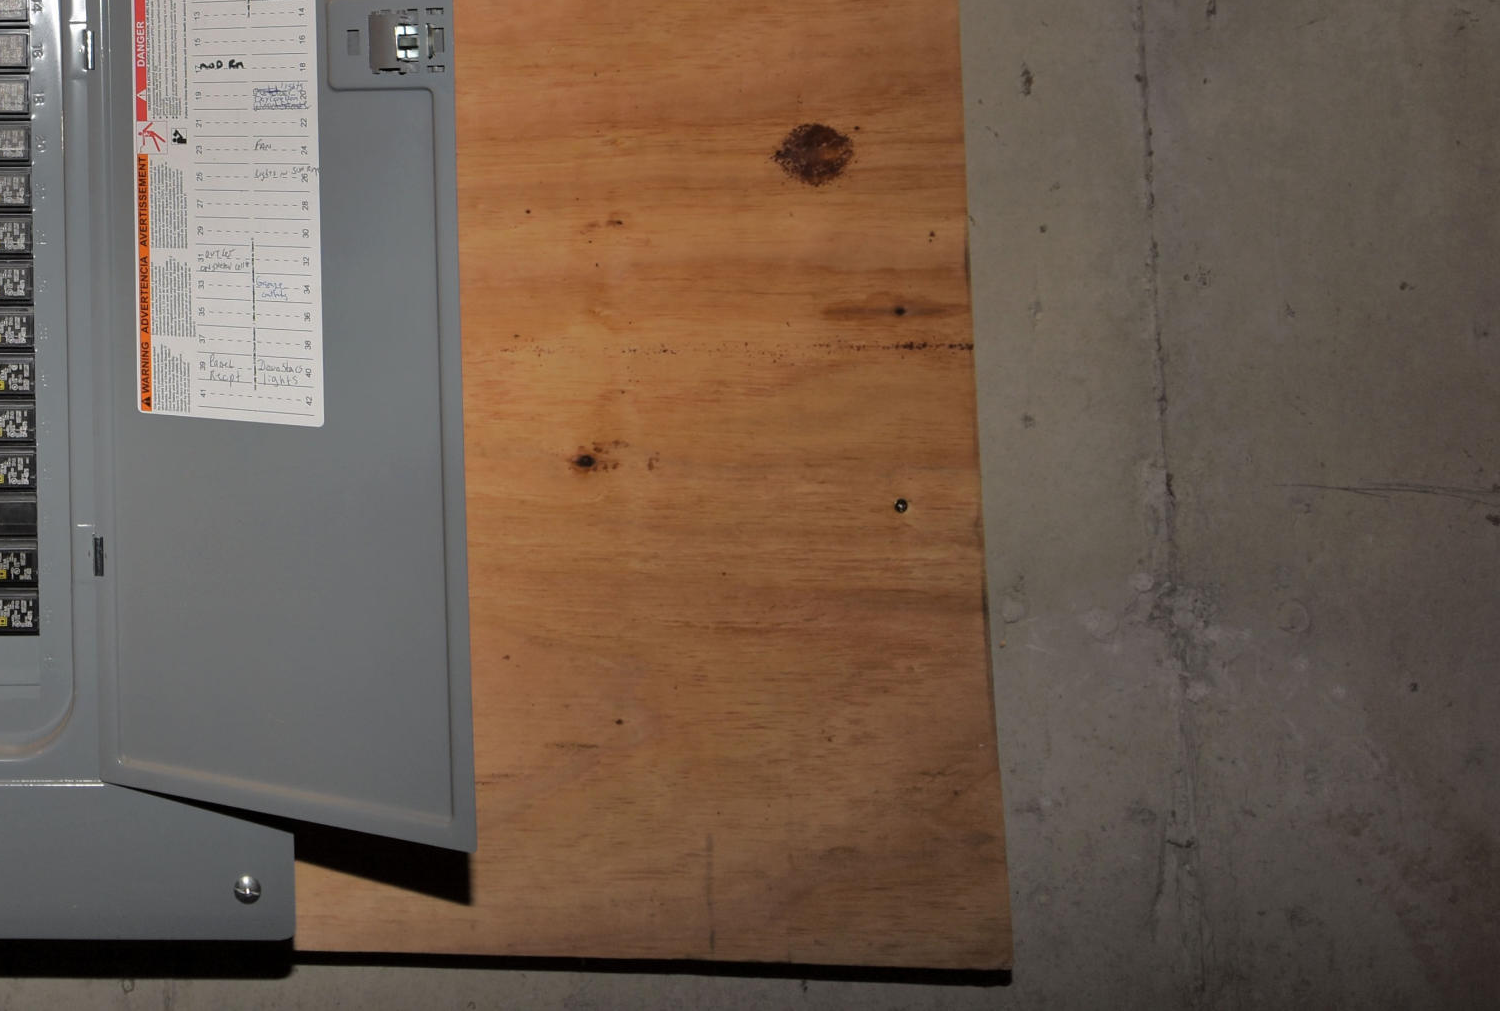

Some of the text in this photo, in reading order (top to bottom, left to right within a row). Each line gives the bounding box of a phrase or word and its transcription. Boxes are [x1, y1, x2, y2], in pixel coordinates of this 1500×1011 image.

[31, 43, 43, 59] 16
[135, 21, 145, 68] DANGER
[138, 156, 148, 247] AVERTISSEMENT
[139, 255, 149, 334] ADVERTENCIA
[141, 341, 150, 394] WARNING
